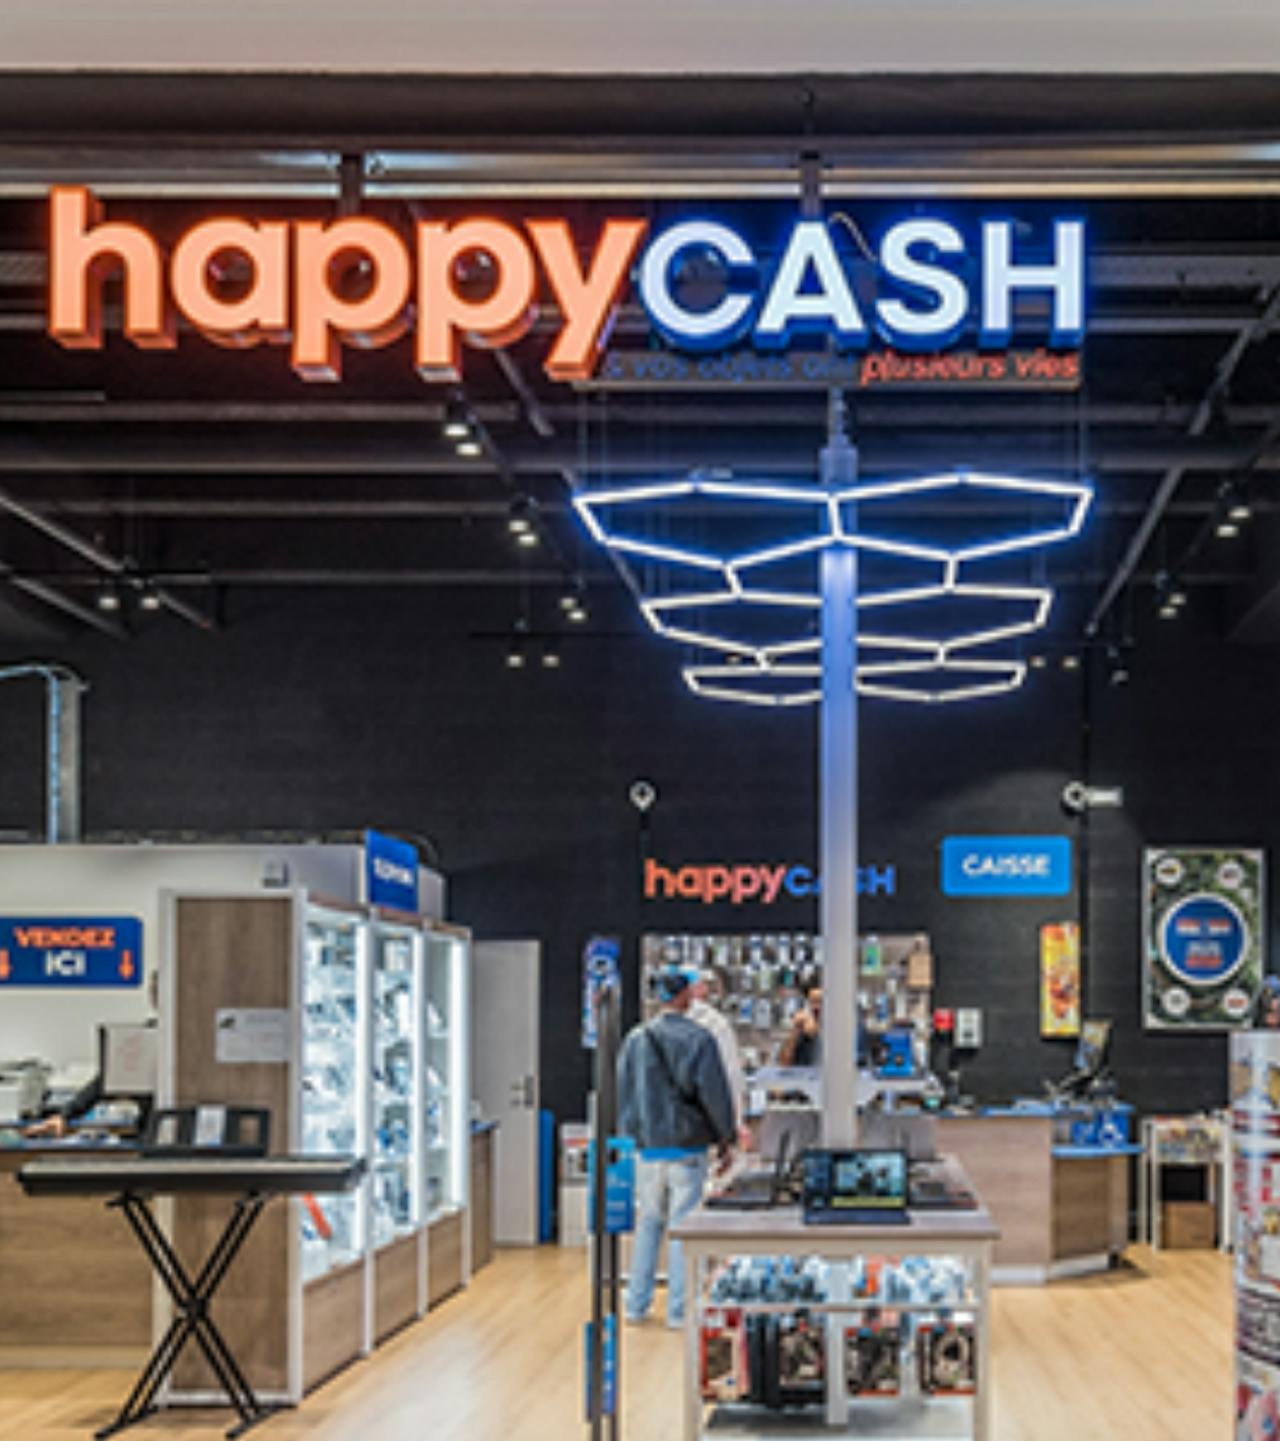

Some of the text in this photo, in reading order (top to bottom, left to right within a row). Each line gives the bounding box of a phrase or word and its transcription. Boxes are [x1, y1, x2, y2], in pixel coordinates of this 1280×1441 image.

[48, 186, 1086, 380] happyCASH
[860, 350, 1005, 386] plusieurs
[1014, 349, 1079, 378] vies
[961, 853, 1050, 877] CAISSE
[13, 926, 116, 948] VENDEZ
[45, 950, 87, 976] ICI
